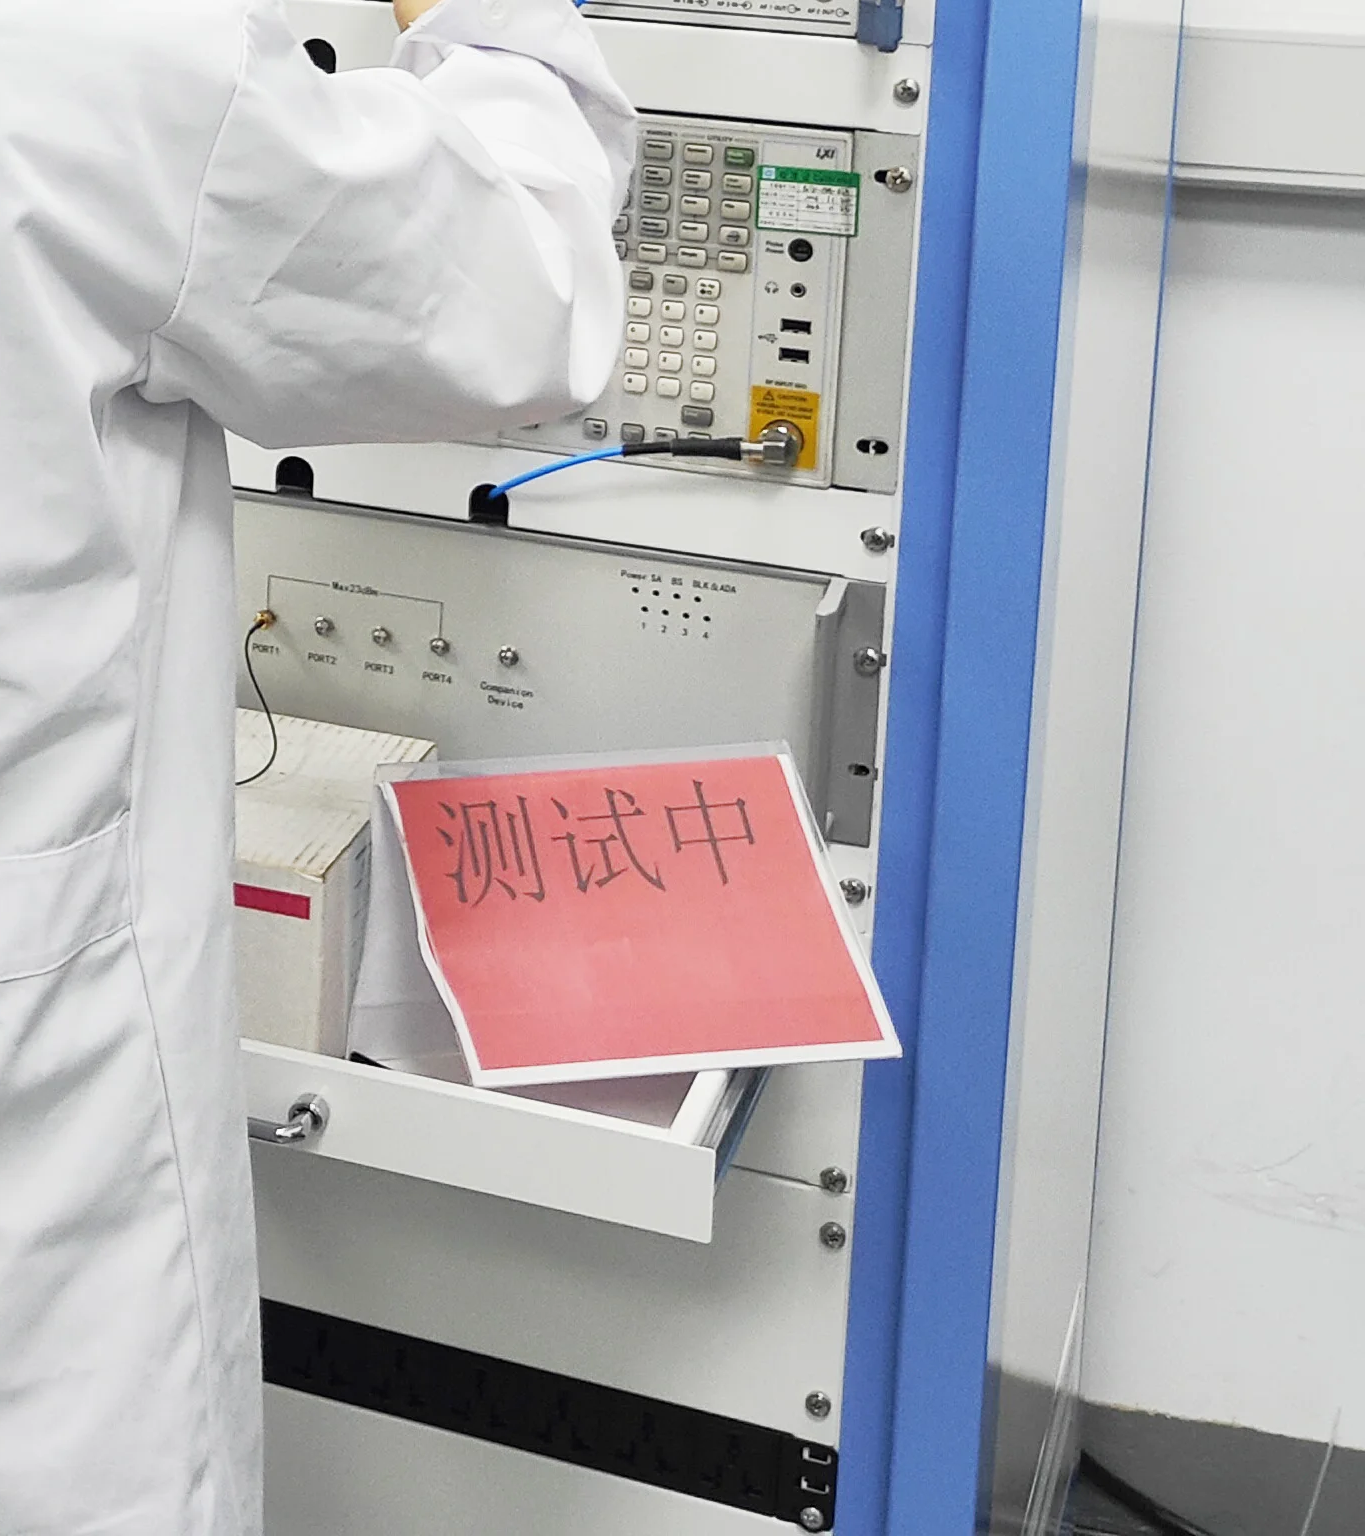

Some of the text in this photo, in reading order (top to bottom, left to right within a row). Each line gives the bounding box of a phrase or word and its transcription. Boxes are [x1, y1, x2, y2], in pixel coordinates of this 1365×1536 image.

[621, 569, 647, 580] Power
[651, 574, 662, 583] SA
[671, 577, 683, 586] BS
[332, 581, 378, 597] Max23dBm
[253, 643, 452, 684] PORT1 PORT2 PORT3 PORT4
[480, 681, 534, 698] Companion
[487, 695, 524, 710] Device
[436, 780, 755, 907] 测试中
